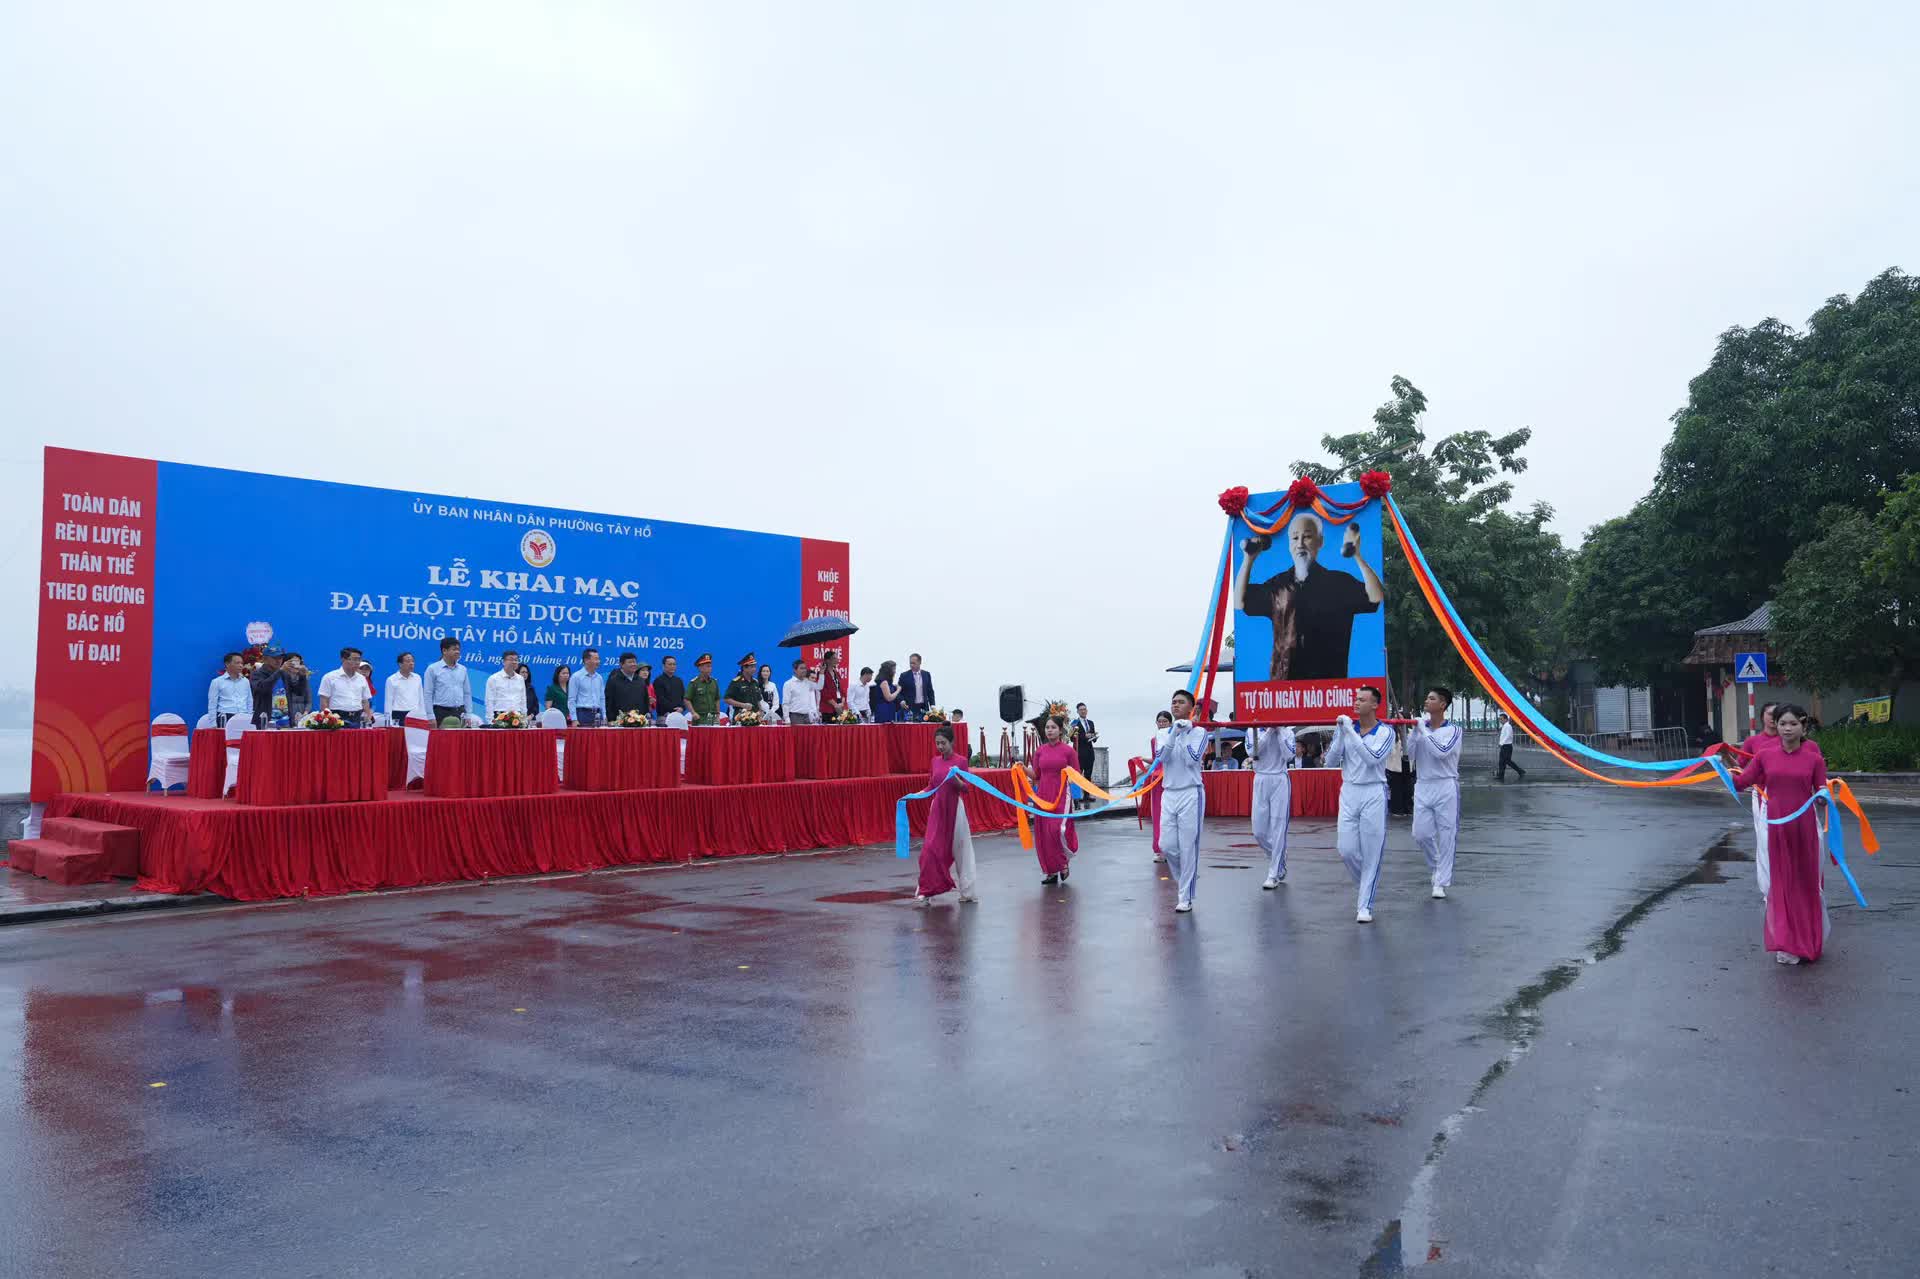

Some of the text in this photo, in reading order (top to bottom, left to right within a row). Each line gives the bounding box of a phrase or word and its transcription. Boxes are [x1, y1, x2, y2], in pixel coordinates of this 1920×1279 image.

[62, 492, 141, 518] TOÀN DÂN
[412, 498, 652, 538] ỦY BAN NHÂN DÂN PHƯỜNG TÂY HỒ
[55, 520, 142, 550] RÈN LUYỆN
[60, 551, 136, 575] THÂN THỂ
[427, 557, 640, 601] LỄ KHAI MẠC
[817, 568, 839, 584] KHỎE
[47, 582, 145, 605] THEO GƯƠNG
[66, 610, 126, 633] BÁC HỒ
[330, 591, 707, 630] ĐẠI HỘI THỂ DỤC THỂ THAO
[363, 622, 446, 641] PHƯỜNG
[452, 624, 487, 643] TÂY
[492, 625, 518, 644] HỒ
[523, 626, 556, 646] LẦN
[560, 630, 595, 648] THỨ
[597, 634, 602, 648] I
[616, 635, 649, 649] NĂM
[653, 637, 684, 651] 2025
[68, 641, 121, 666] VĨ ĐẠI!
[465, 651, 485, 664] Hồ,
[532, 655, 562, 667] tháng
[565, 656, 577, 665] 10
[1258, 688, 1273, 709] TÔI
[1275, 687, 1301, 709] NGÀY
[1303, 686, 1323, 708] NÀO
[1325, 685, 1353, 707] CŨNG
